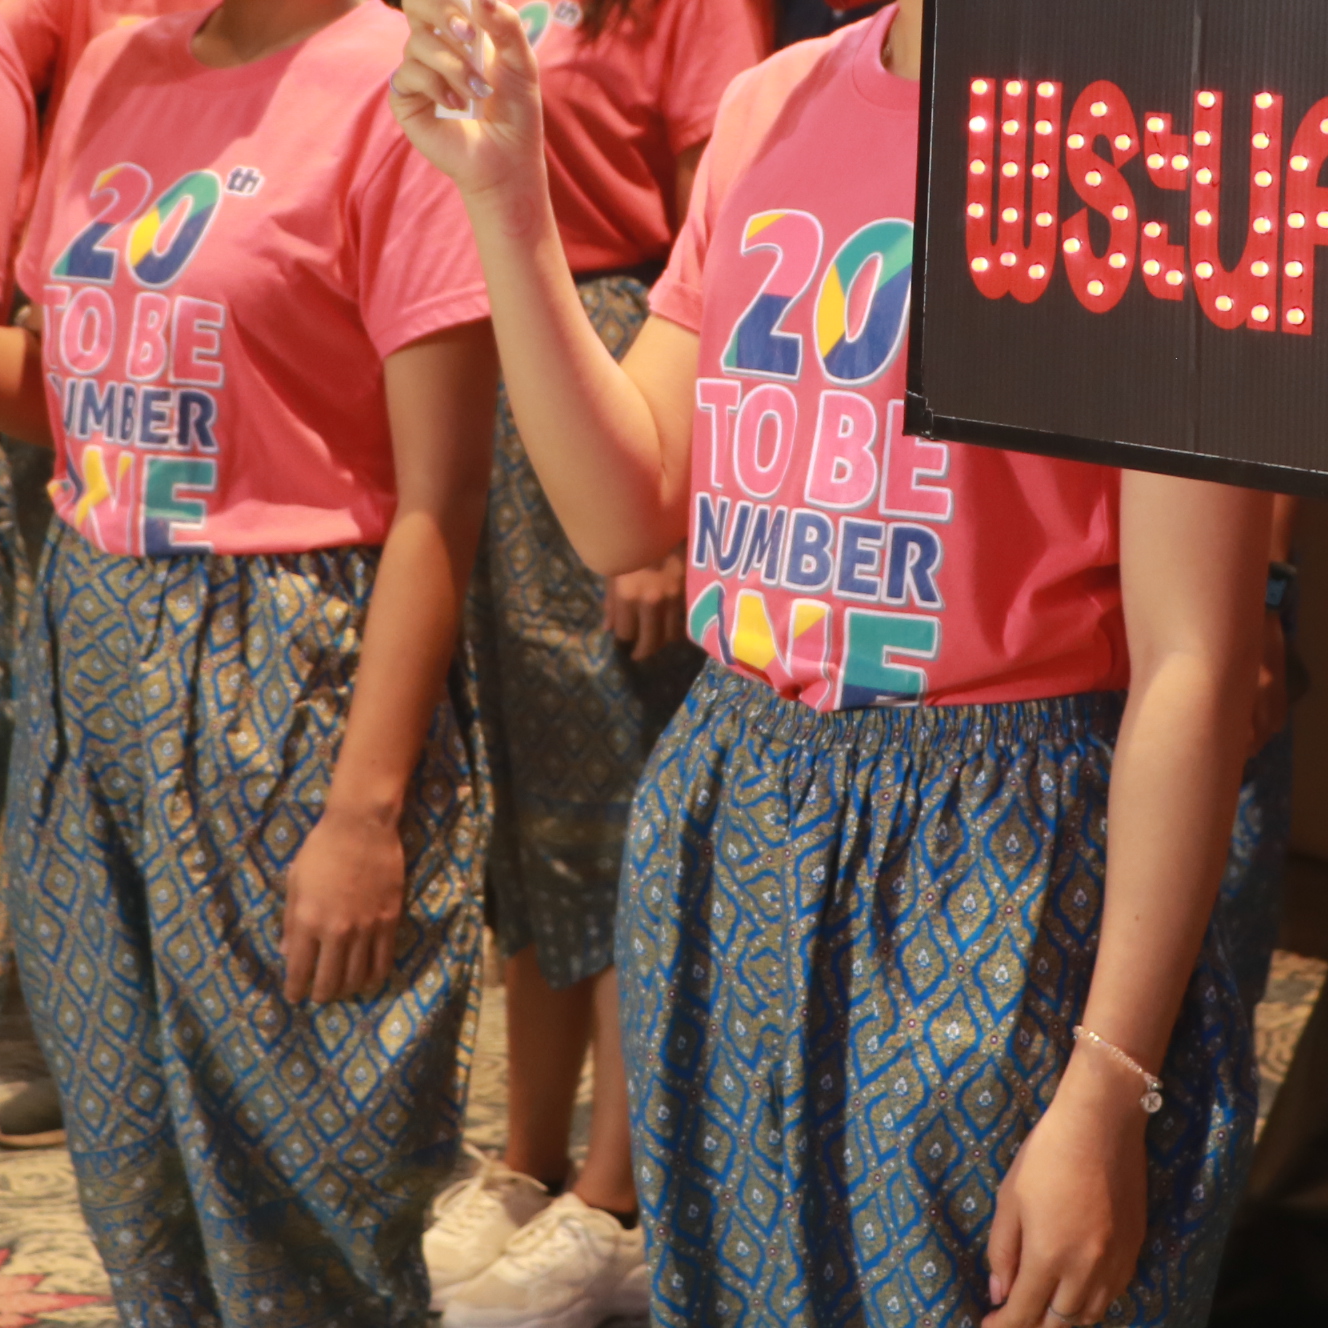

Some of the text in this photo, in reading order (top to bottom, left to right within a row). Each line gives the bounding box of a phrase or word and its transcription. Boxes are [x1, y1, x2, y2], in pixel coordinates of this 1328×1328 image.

[42, 284, 226, 387] TO BE
[696, 378, 954, 522] TO BE
[692, 491, 945, 610] NUMBER
